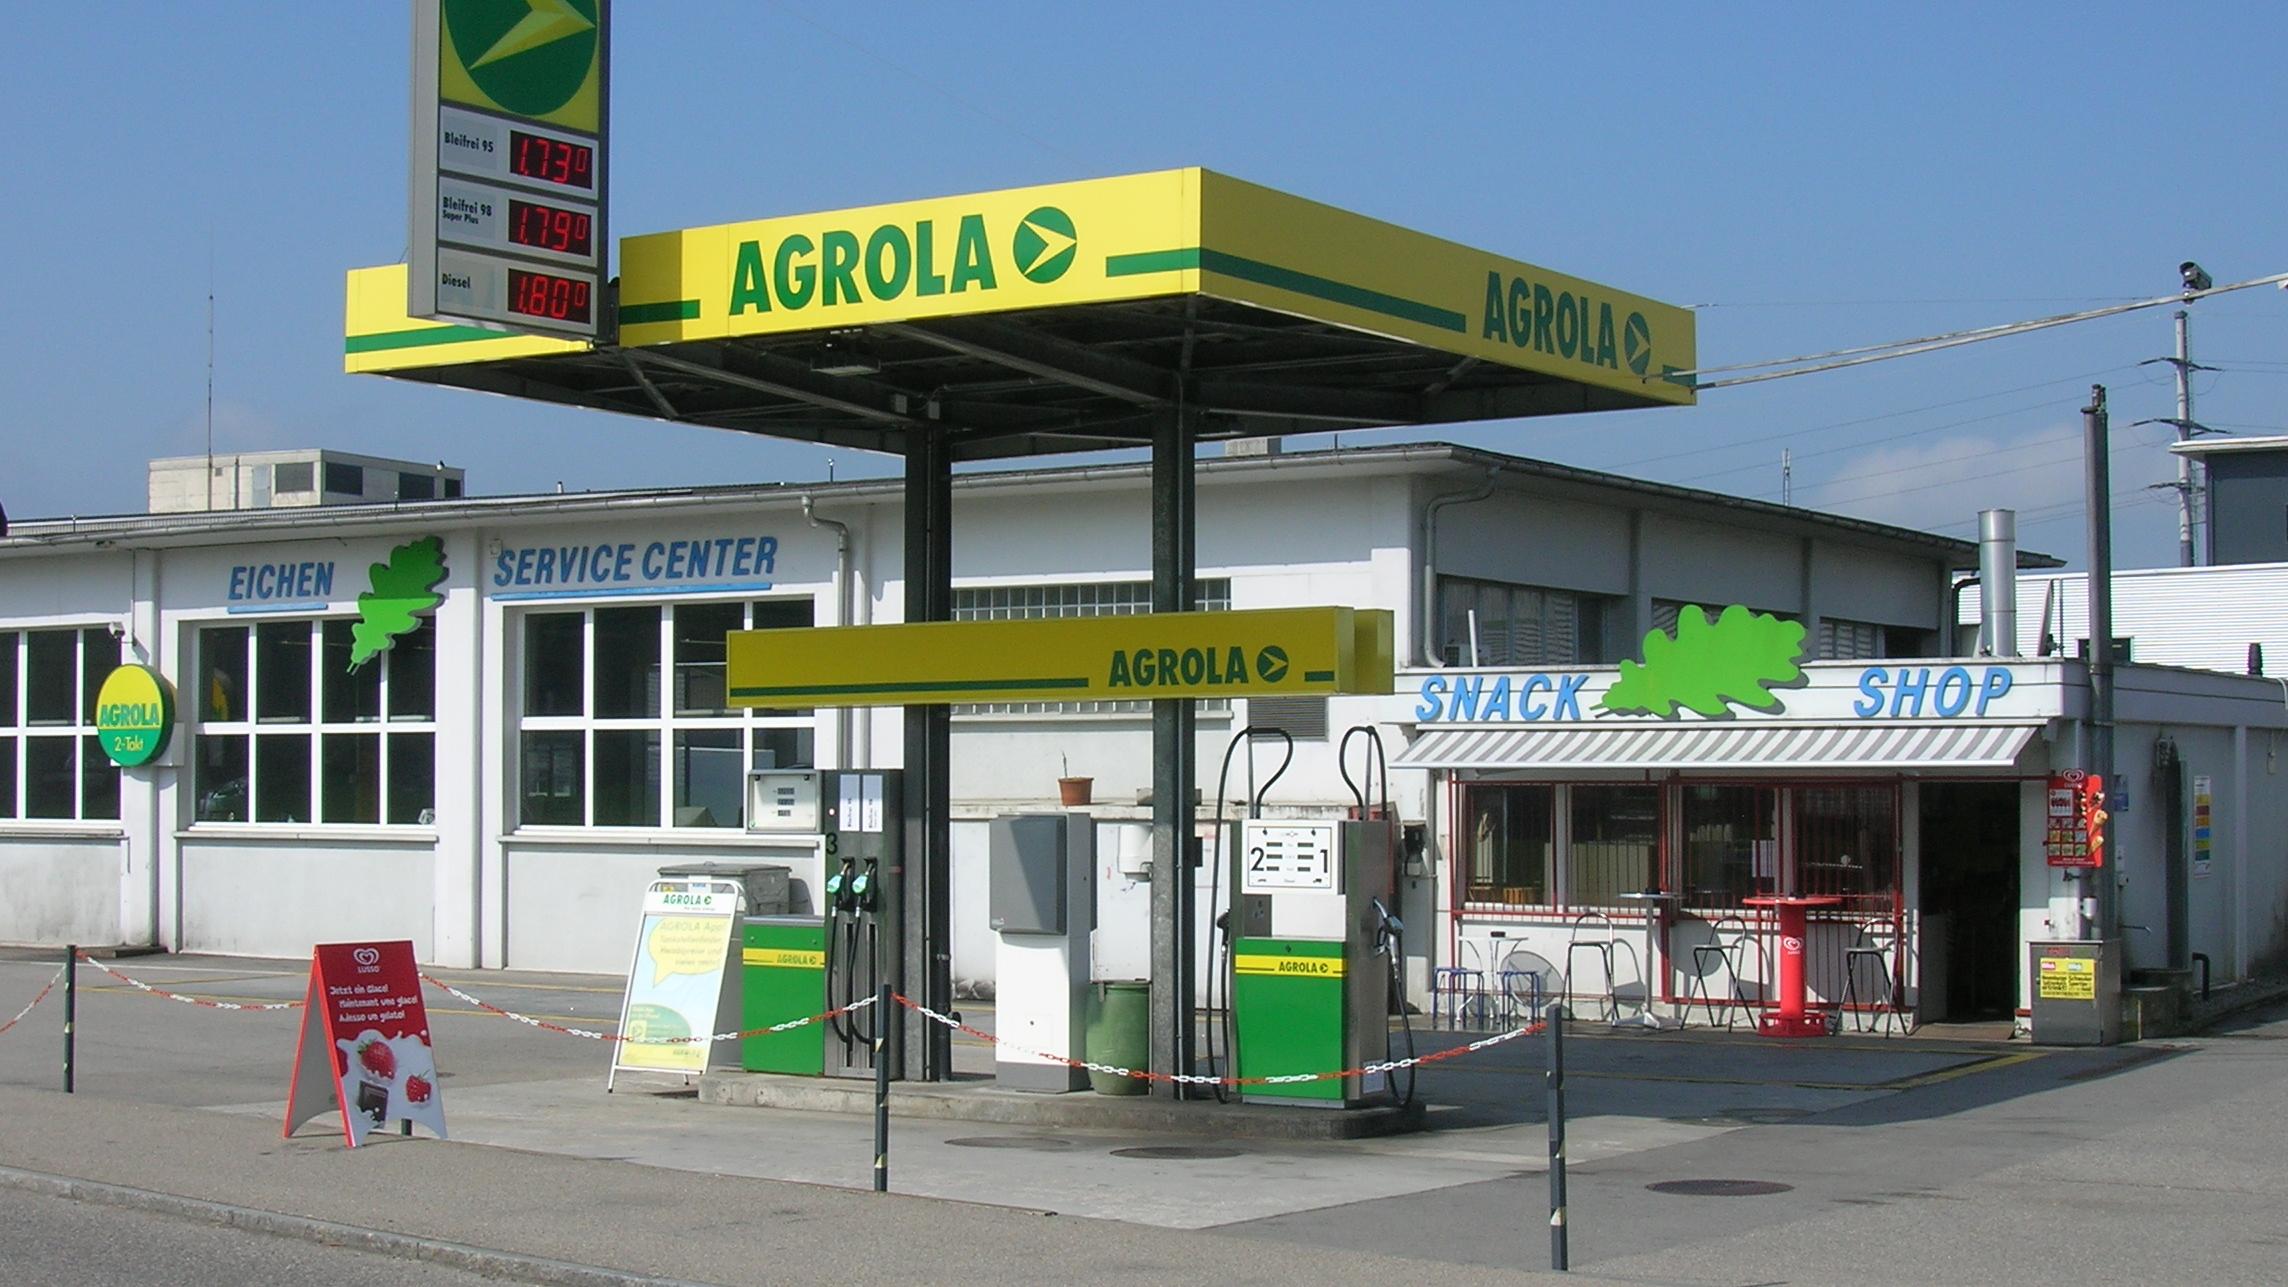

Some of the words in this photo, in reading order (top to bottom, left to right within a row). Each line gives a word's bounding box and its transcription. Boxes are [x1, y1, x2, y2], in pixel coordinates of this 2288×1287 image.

[444, 131, 480, 151] Bleifrei
[482, 138, 494, 153] 95
[442, 196, 478, 215] Bleifrei
[480, 201, 492, 217] 98
[442, 210, 462, 223] Super
[464, 213, 479, 225] Plus
[728, 213, 998, 317] AGROLA
[442, 273, 471, 289] Diesel
[1483, 270, 1618, 370] AGROLA
[493, 544, 635, 587] SERVICE
[642, 536, 778, 581] CENTER
[228, 561, 335, 600] EICHEN
[1108, 646, 1249, 688] AGROLA
[1415, 674, 1590, 722] SNACK
[1853, 667, 2014, 720] SHOP
[100, 703, 160, 727] AGROLA
[114, 735, 144, 752] 2-Takt
[825, 832, 839, 855] 3
[1250, 846, 1265, 872] 2
[1319, 849, 1329, 873] 1
[663, 893, 702, 905] AGROLA
[777, 953, 811, 965] AGROLA
[1278, 961, 1318, 973] AGROLA
[354, 984, 366, 995] ein
